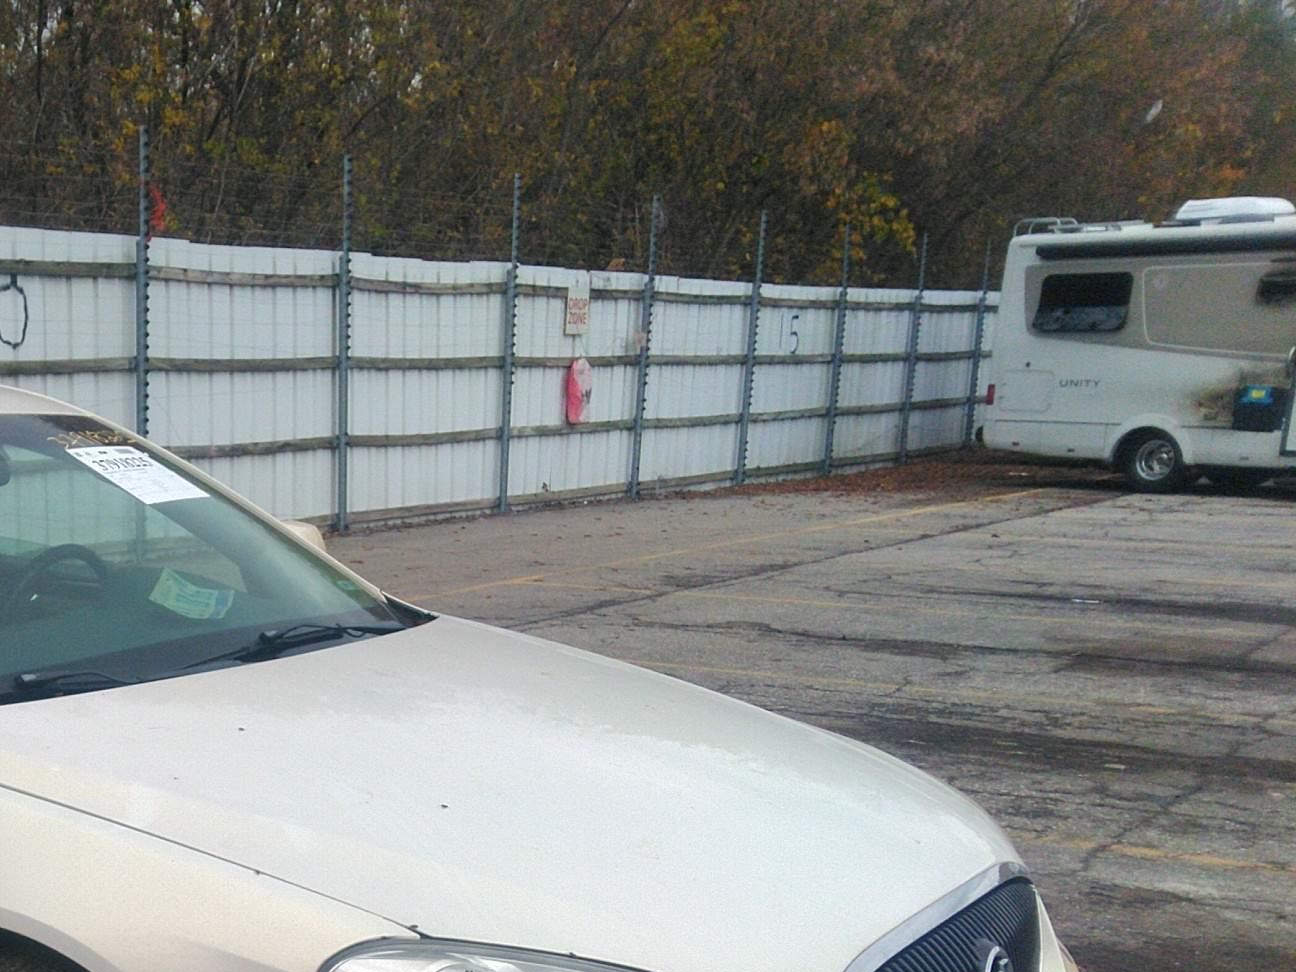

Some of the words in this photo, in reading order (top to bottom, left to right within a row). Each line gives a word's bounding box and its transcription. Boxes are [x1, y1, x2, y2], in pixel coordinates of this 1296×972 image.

[568, 297, 587, 310] DROP
[567, 311, 587, 325] ZONE
[778, 312, 800, 354] 15
[1059, 379, 1101, 388] UNITY
